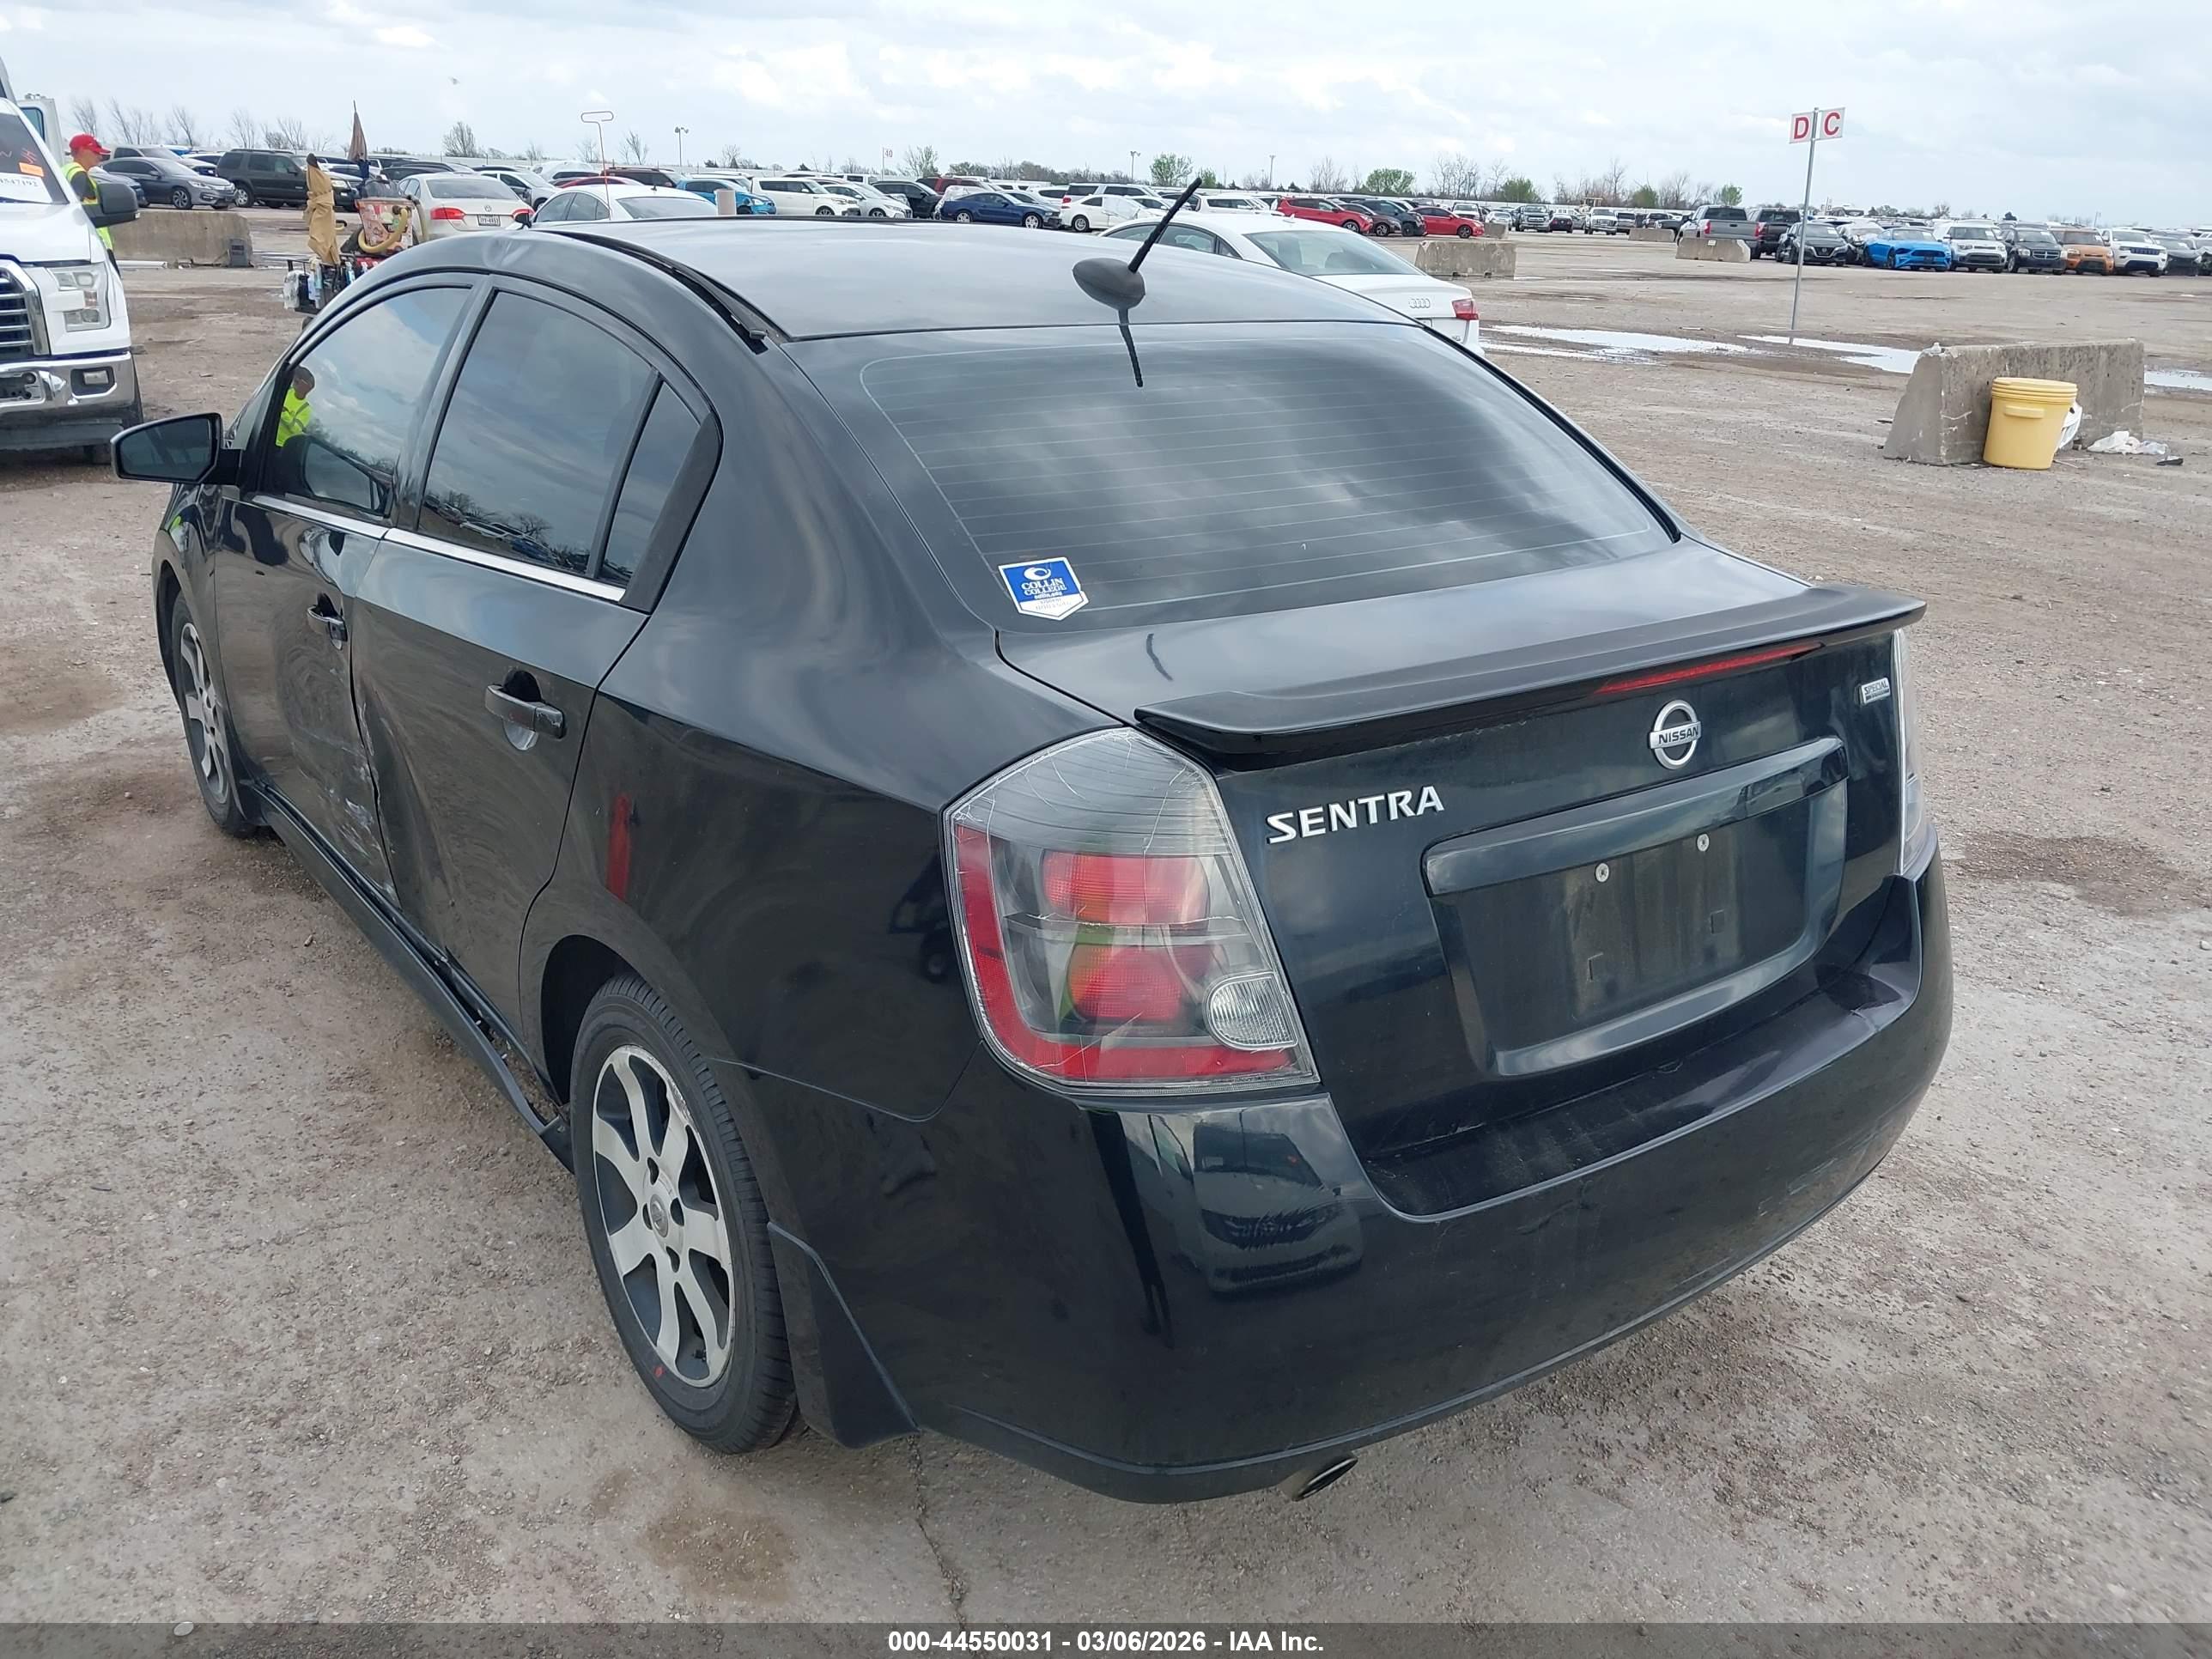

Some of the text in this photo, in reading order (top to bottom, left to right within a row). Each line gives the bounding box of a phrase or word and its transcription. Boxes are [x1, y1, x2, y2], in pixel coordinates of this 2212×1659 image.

[1794, 116, 1809, 140] D
[1824, 112, 1841, 136] C
[885, 149, 893, 158] 40
[1021, 577, 1065, 590] COLLIN
[1024, 585, 1067, 596] COLLEGE
[1658, 726, 1698, 744] NISSAN
[1265, 785, 1445, 844] SENTRA
